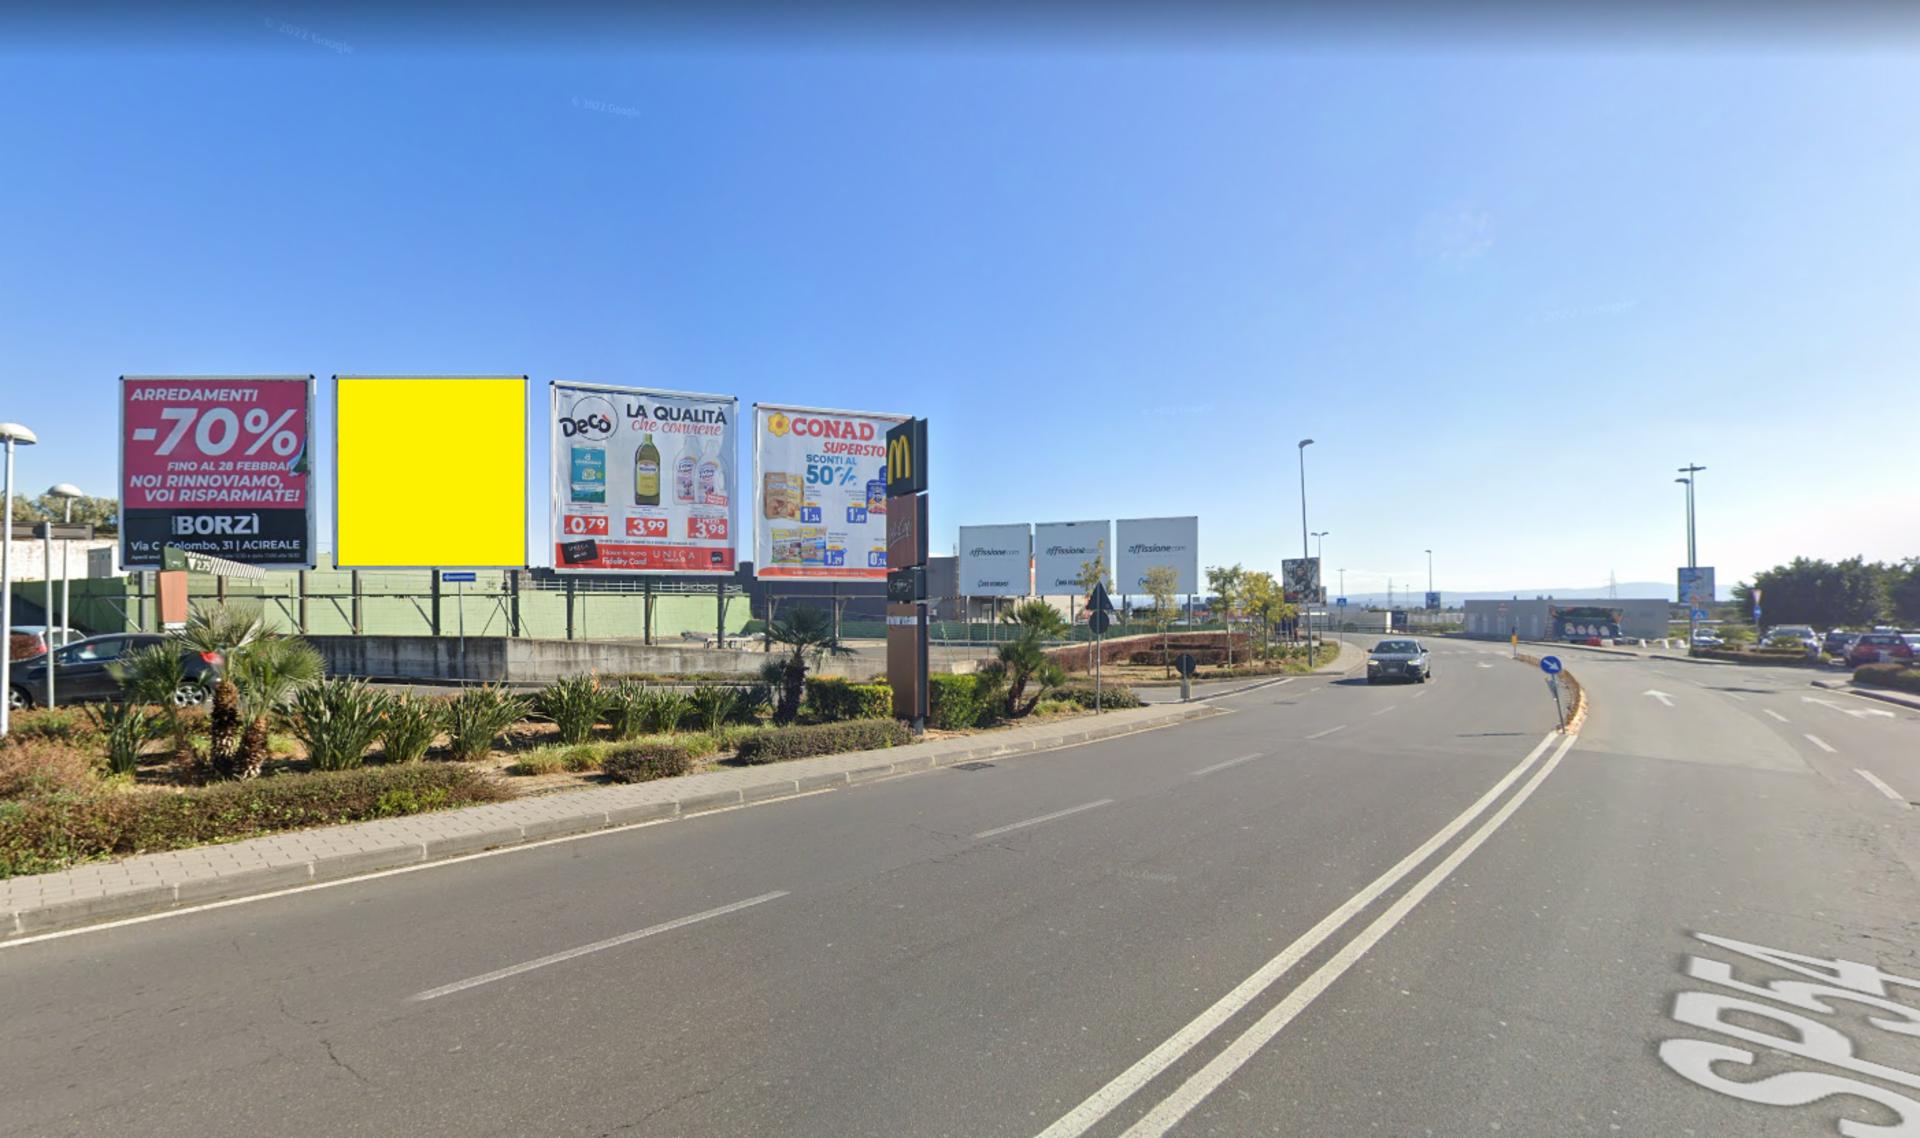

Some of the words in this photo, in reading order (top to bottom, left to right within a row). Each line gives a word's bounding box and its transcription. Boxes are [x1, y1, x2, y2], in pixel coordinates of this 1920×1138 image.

[131, 388, 258, 402] ARREDAMENTI
[626, 403, 648, 419] LA
[653, 405, 728, 425] QUALITÀ
[132, 407, 298, 456] -70%
[631, 416, 657, 432] che
[661, 420, 722, 436] conviene
[791, 417, 875, 441] CONAD
[823, 442, 887, 458] SUPERSTO
[167, 462, 197, 471] FINO
[200, 462, 215, 471] AL
[219, 462, 233, 471] 28
[806, 454, 843, 465] SCONTI
[845, 455, 858, 466] AL
[130, 475, 161, 487] NOI
[166, 475, 284, 490] RINNOVIAMO,
[806, 465, 858, 487] 50%
[144, 489, 174, 502] VOI
[179, 489, 300, 502] RISPARMIATE!
[177, 512, 259, 535] BORZÌ
[570, 517, 606, 534] 0,79
[633, 520, 665, 535] 3,99
[131, 541, 148, 551] Via
[223, 540, 234, 550] 31
[243, 540, 300, 550] ACIREALE
